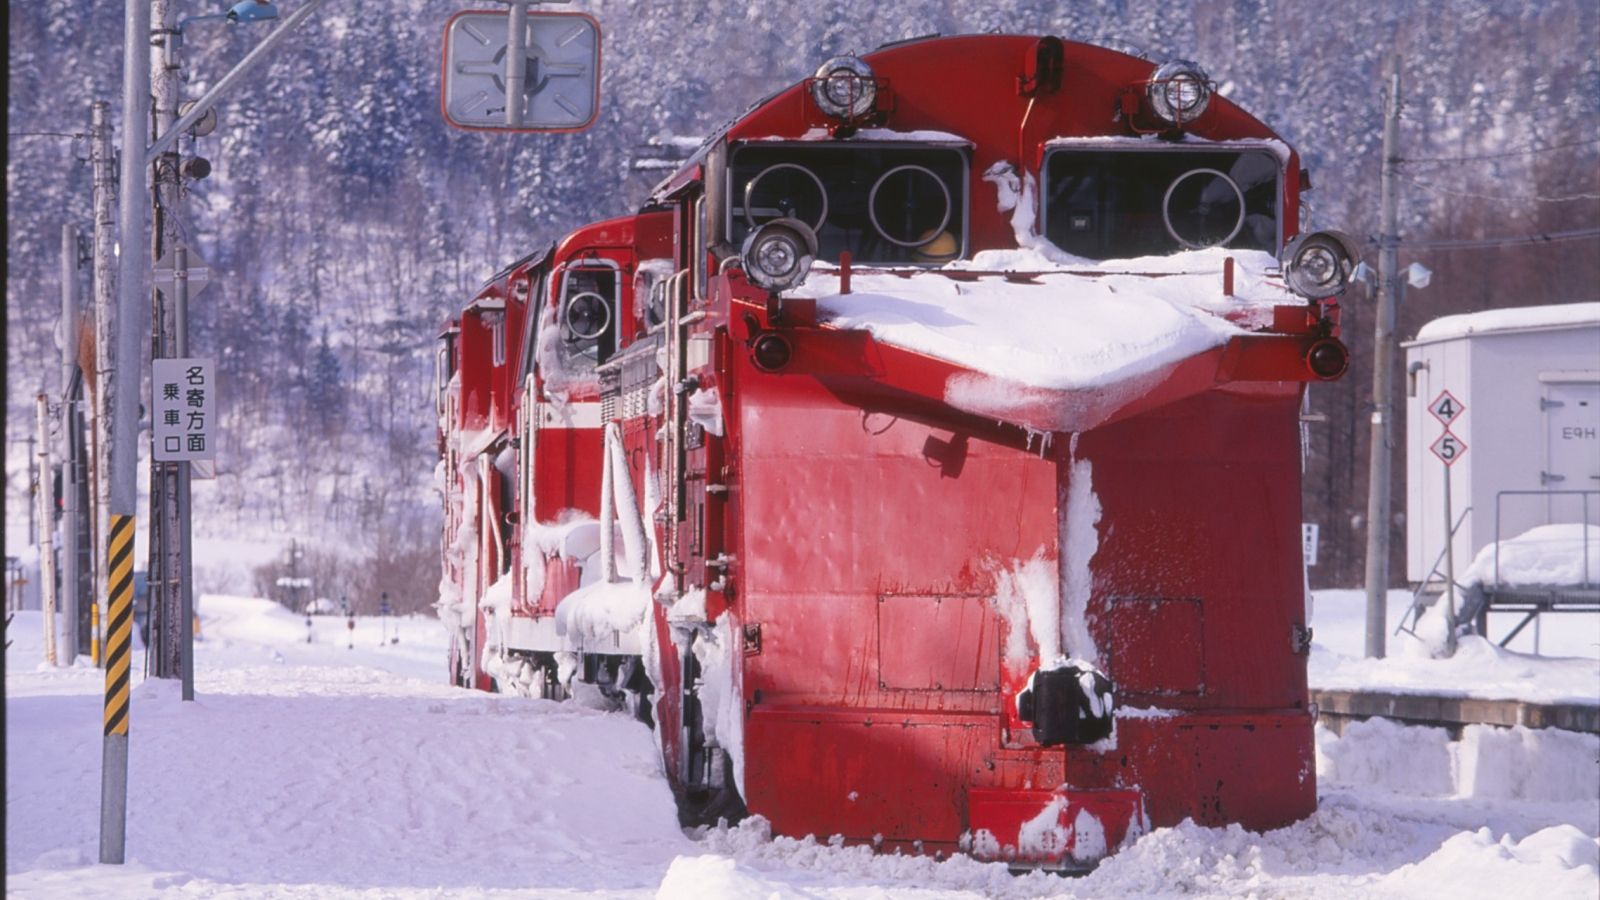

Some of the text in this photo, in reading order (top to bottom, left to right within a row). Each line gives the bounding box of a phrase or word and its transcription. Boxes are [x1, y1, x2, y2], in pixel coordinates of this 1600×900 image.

[163, 383, 181, 453] 乗車口
[186, 366, 205, 452] 名寄方面
[1438, 398, 1455, 419] 4
[1442, 438, 1456, 460] 5
